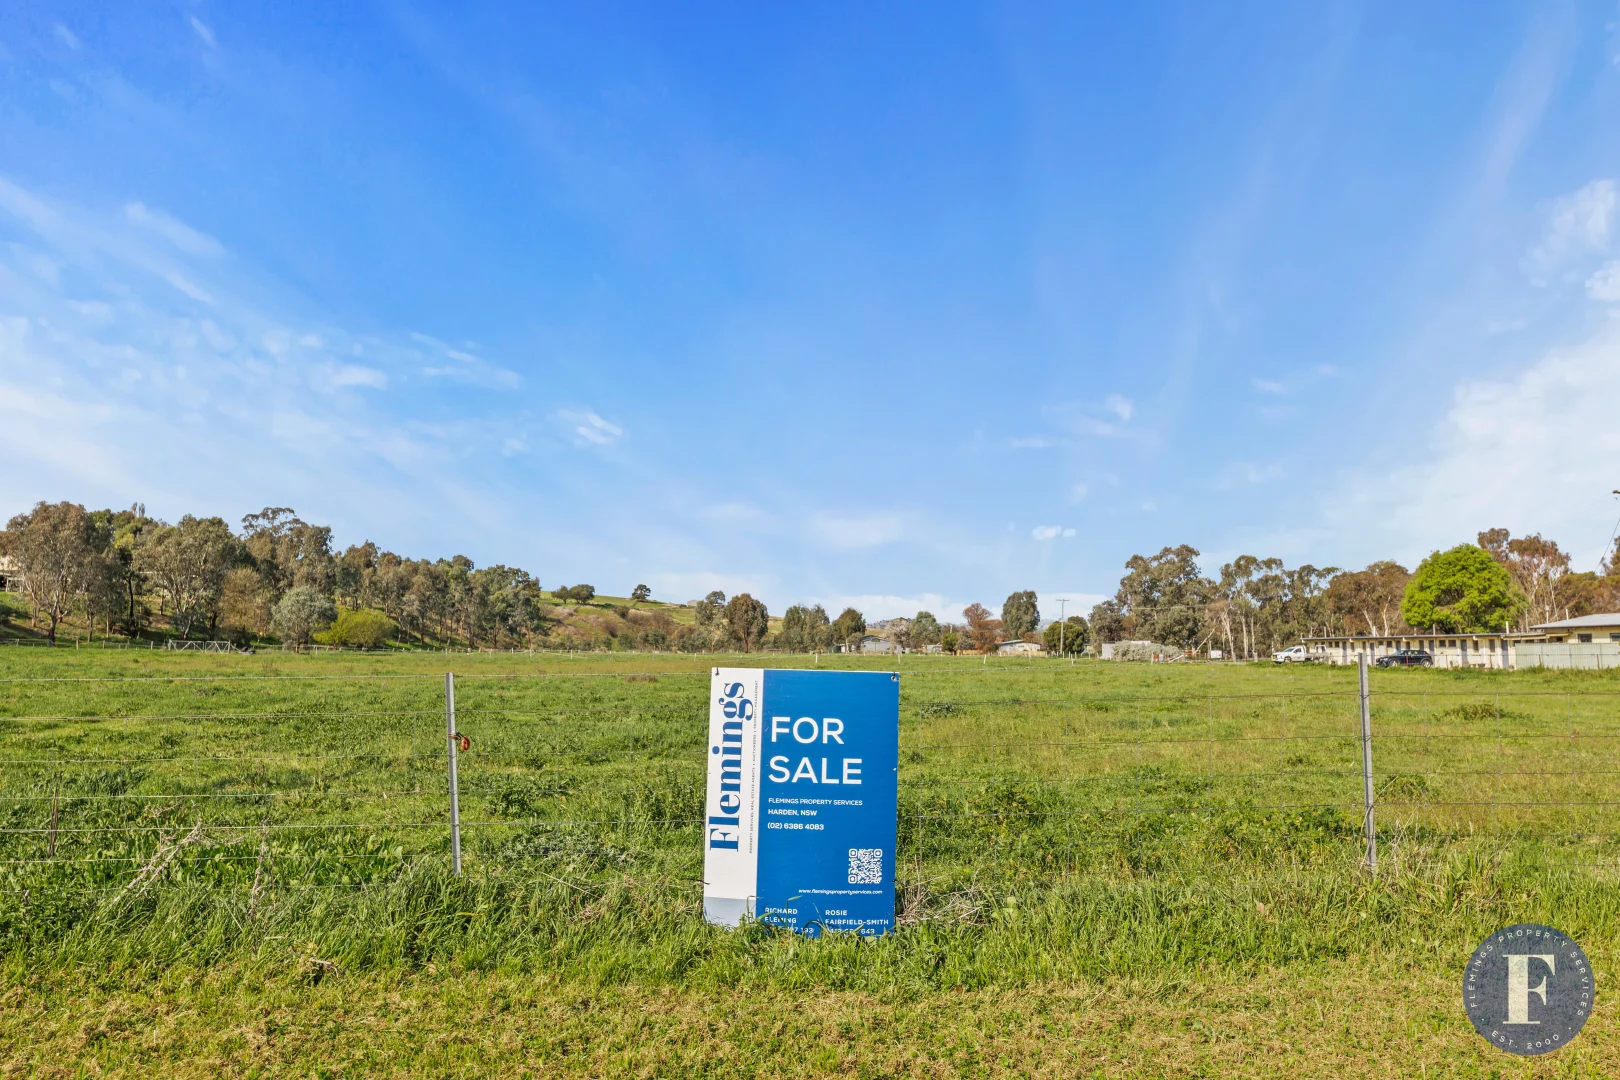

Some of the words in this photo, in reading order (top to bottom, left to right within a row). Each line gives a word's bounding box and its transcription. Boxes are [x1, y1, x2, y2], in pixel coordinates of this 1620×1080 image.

[771, 716, 845, 745] FOR
[708, 682, 754, 852] Flemings
[768, 756, 863, 785] SALE
[768, 797, 799, 805] FLEMINGS
[767, 808, 799, 816] HARDEN,
[767, 822, 783, 830] (02)
[783, 822, 803, 830] 6386
[804, 823, 825, 831] 4083
[798, 888, 883, 896] www.flemingspropertyservices.com
[765, 907, 798, 915] RICHARD
